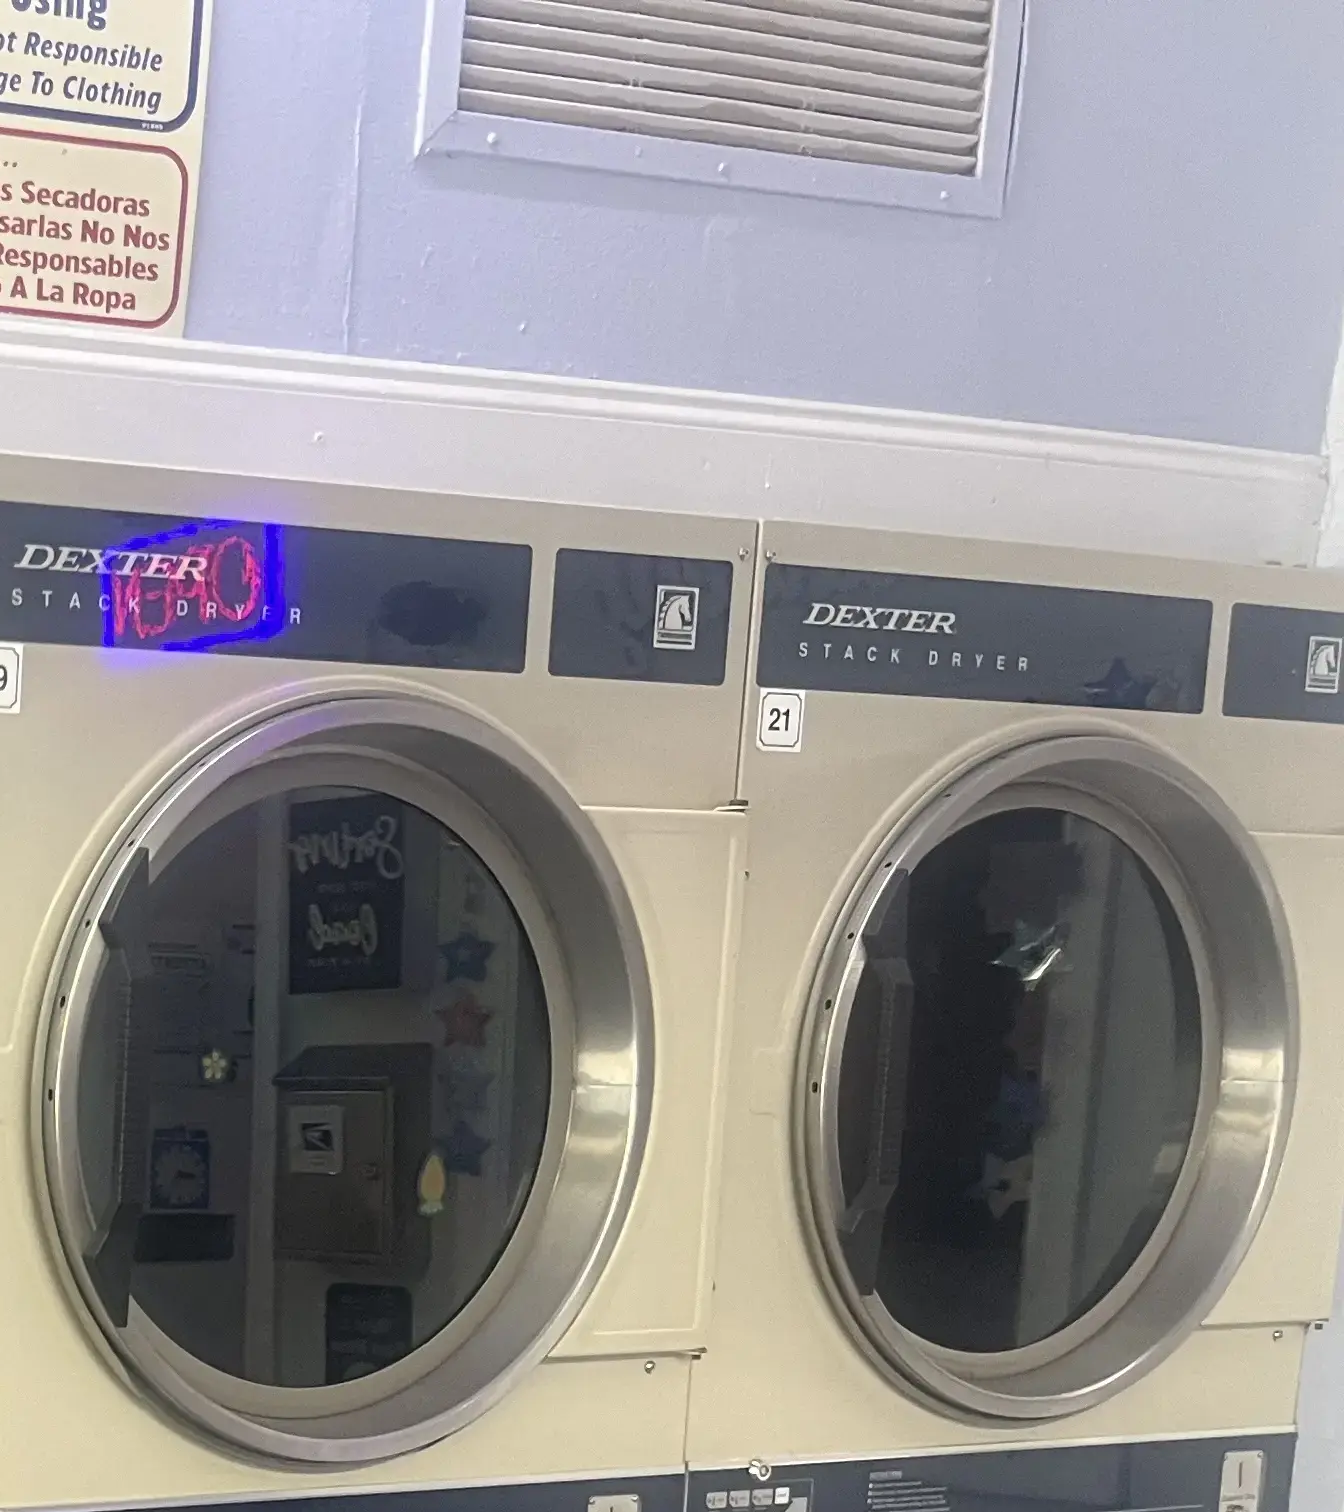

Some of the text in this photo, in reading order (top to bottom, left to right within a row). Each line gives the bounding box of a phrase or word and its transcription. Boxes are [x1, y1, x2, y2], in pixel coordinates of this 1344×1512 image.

[24, 32, 163, 72] Responsible
[31, 71, 54, 97] To
[63, 76, 162, 114] Clothing
[20, 180, 150, 217] Secadoras
[81, 220, 114, 244] No
[123, 224, 170, 251] Nos
[11, 276, 28, 299] A
[37, 281, 63, 303] La
[73, 285, 136, 314] Ropa
[14, 544, 208, 582] DEXTER
[11, 588, 140, 614] STACK
[803, 603, 957, 635] DEXTER
[799, 642, 1028, 672] STACK DRYER
[768, 707, 791, 732] 21
